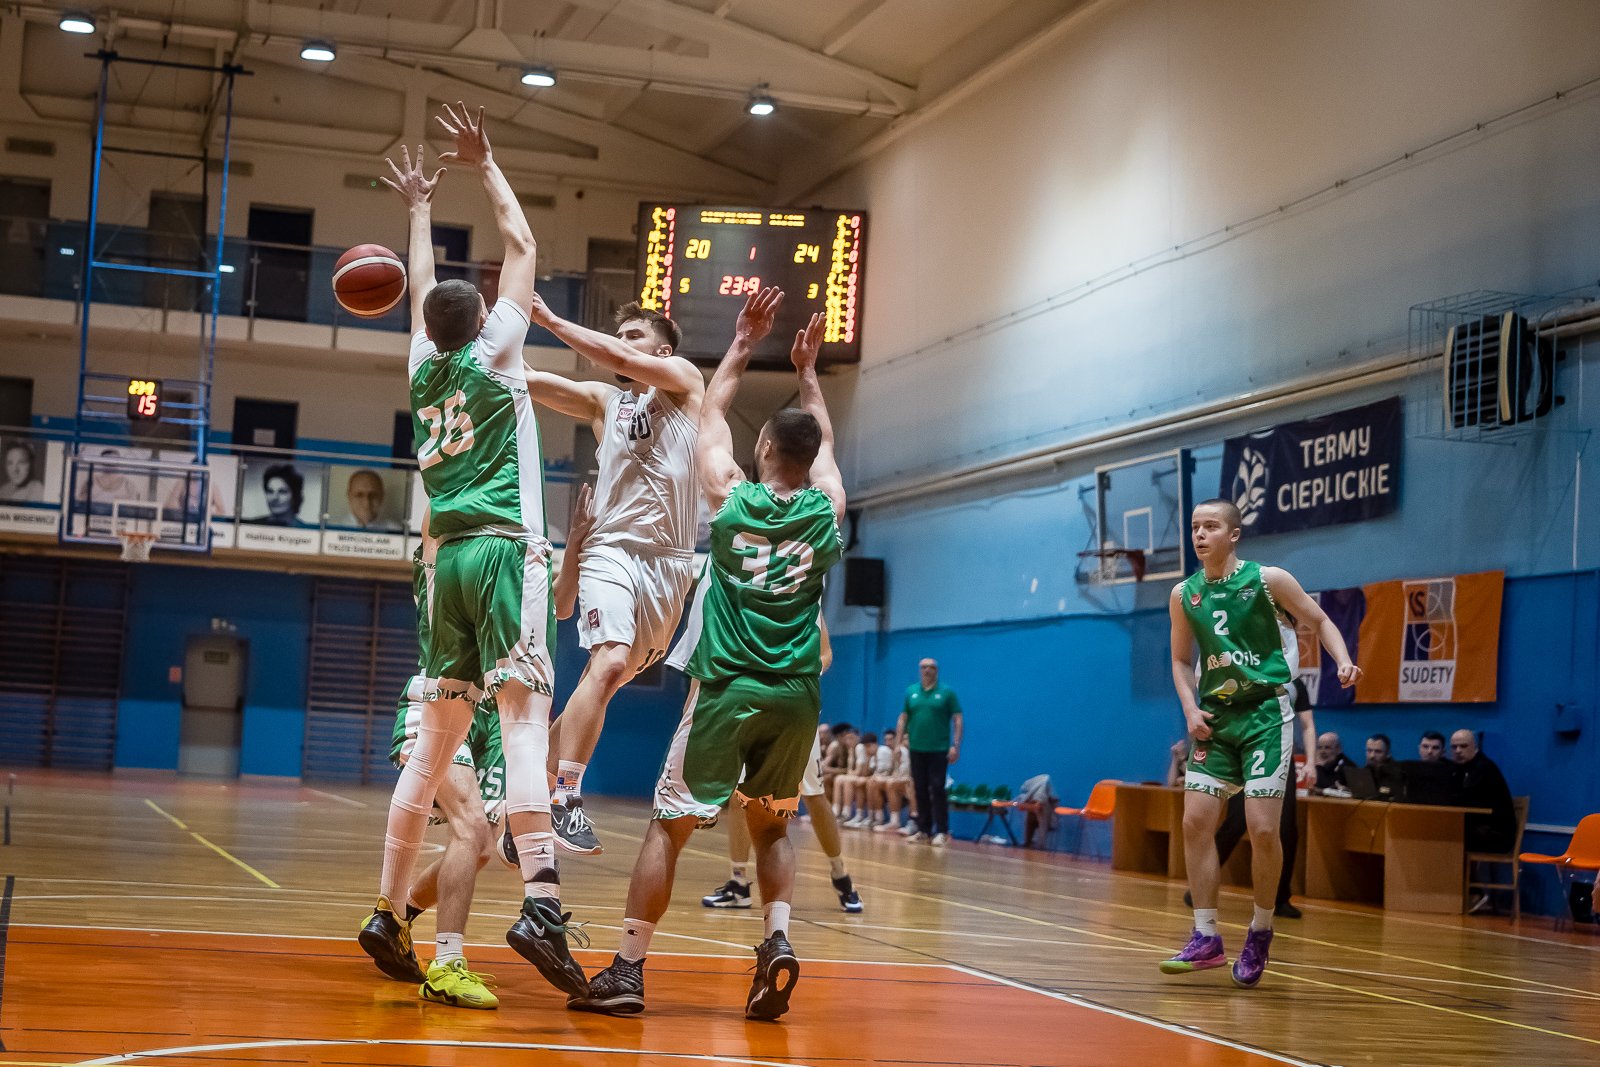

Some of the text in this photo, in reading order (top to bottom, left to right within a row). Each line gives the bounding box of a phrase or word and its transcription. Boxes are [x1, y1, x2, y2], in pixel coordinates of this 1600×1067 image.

[685, 239, 711, 259] 20
[750, 246, 757, 260] 1
[793, 244, 820, 263] 24
[679, 278, 690, 294] 5
[807, 283, 819, 299] 3
[138, 395, 157, 415] 15
[417, 390, 475, 471] 26
[1300, 425, 1371, 468] TERMY
[1277, 463, 1391, 512] CIEPLICKIE
[1212, 610, 1230, 635] 2
[1402, 665, 1453, 685] SUDETY
[1250, 750, 1266, 775] 2
